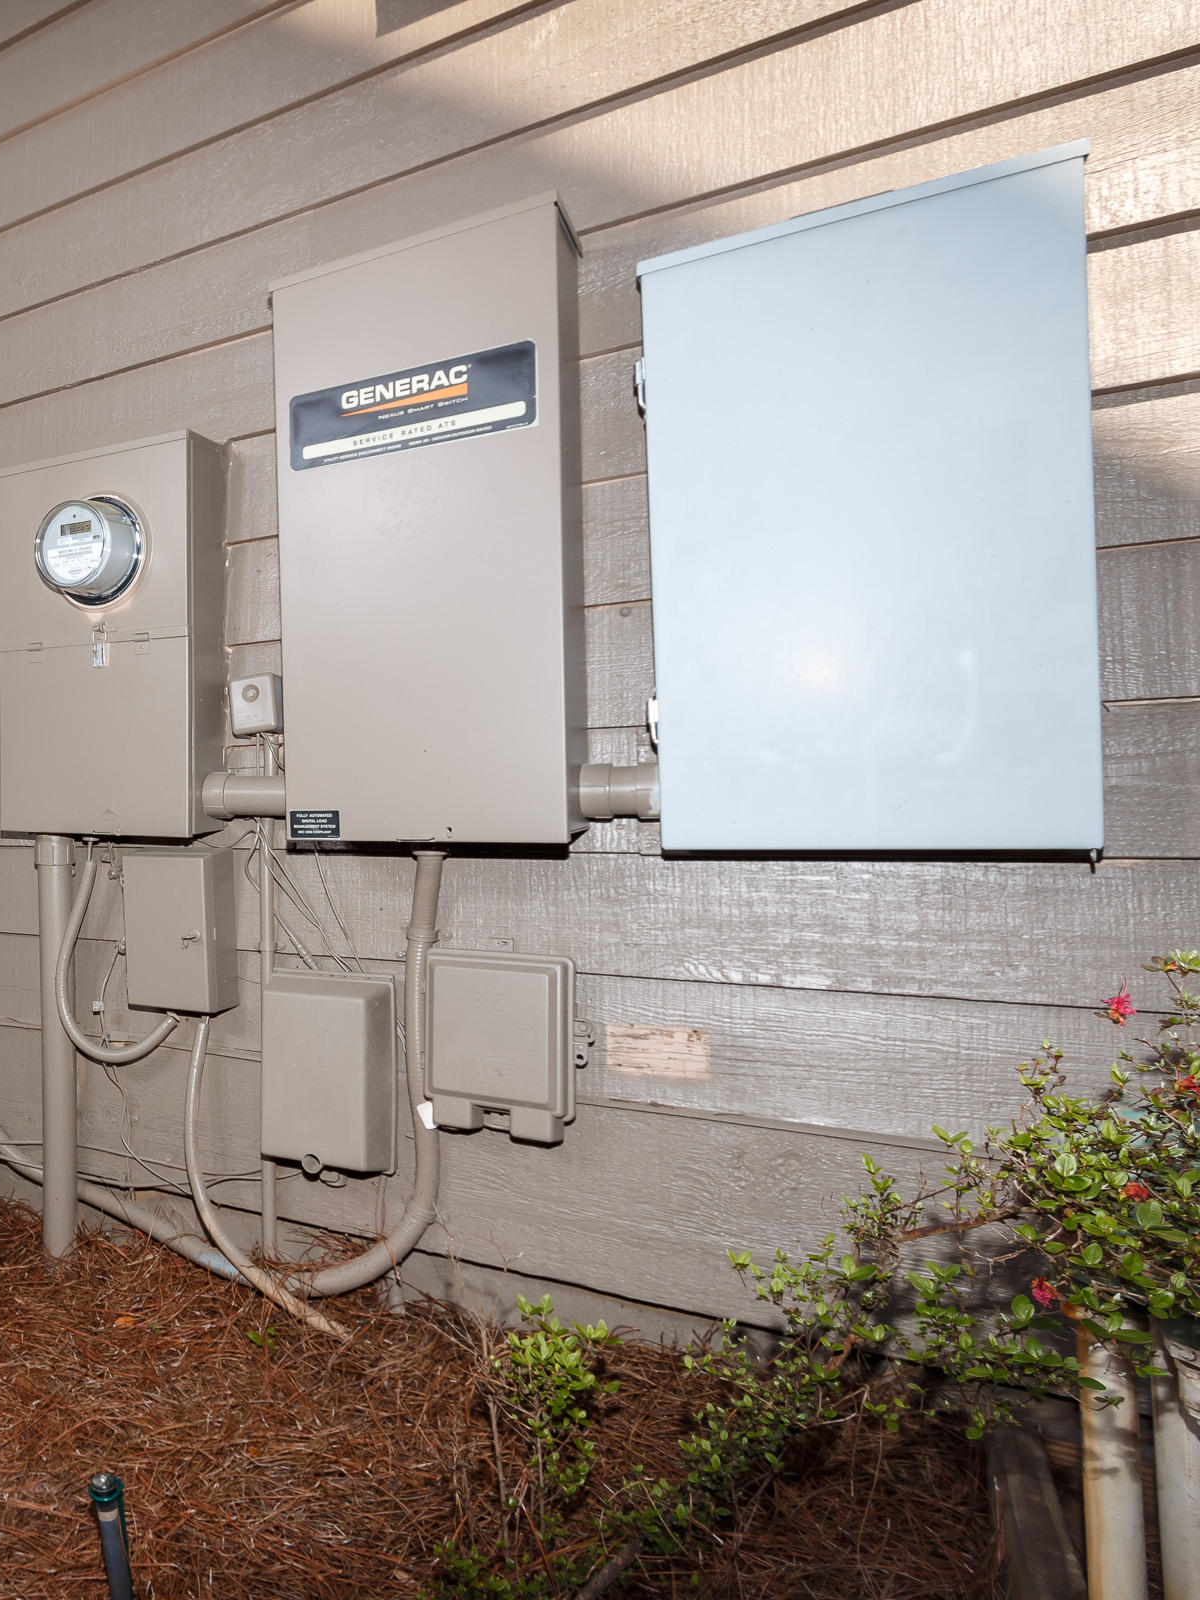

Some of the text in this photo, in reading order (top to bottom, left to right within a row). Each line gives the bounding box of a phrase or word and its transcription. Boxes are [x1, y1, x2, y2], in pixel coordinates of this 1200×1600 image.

[341, 364, 468, 410] GENERAC
[352, 419, 457, 447] SERVICE RATED ATS
